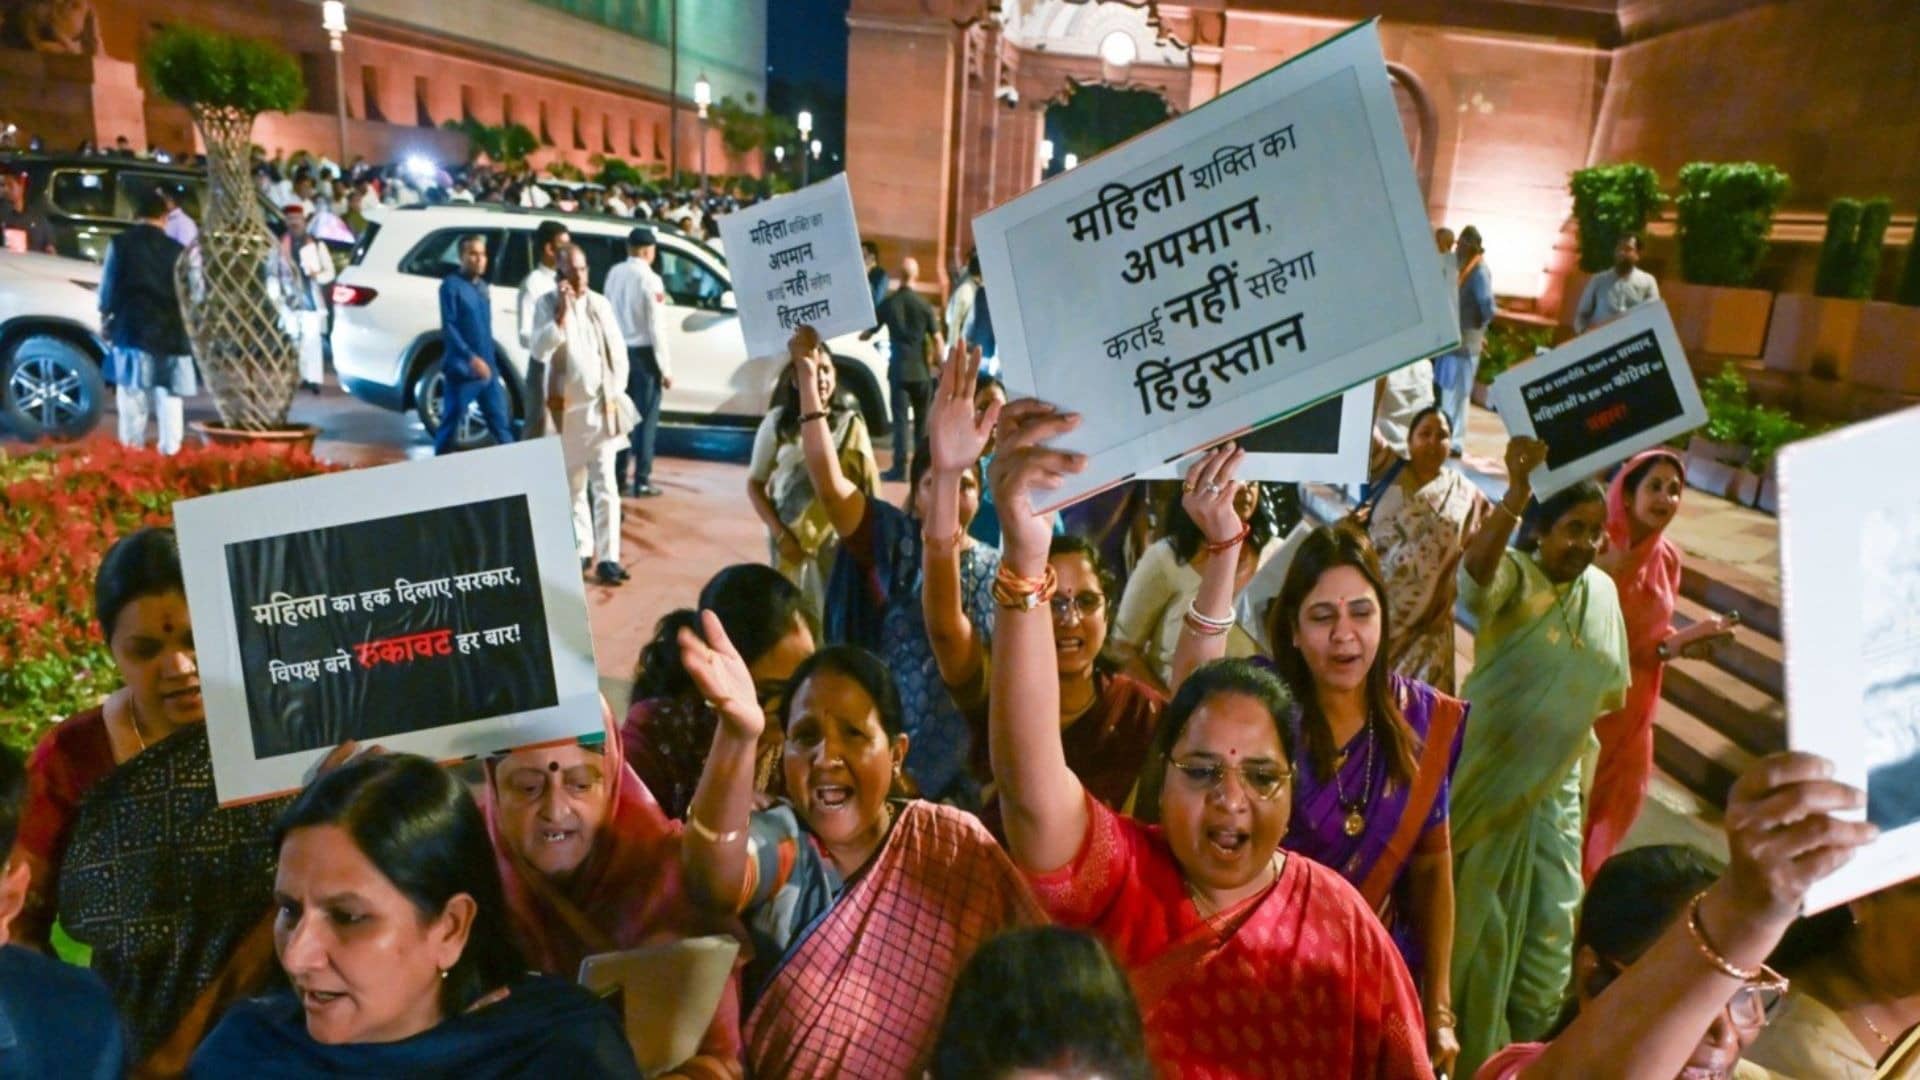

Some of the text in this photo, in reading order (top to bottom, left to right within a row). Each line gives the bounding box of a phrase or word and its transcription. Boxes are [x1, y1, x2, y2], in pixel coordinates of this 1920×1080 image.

[1066, 123, 1297, 245] महिला शक्ति का
[749, 219, 788, 245] महिला
[768, 242, 813, 270] अपमान
[1120, 195, 1273, 285] अपमान,
[784, 269, 809, 296] नहीं
[1103, 250, 1318, 361] कतई नहीं सहेगा
[1134, 312, 1307, 416] हिंदुस्तान
[251, 566, 521, 627] महिला का हक दिलाए सरकार,
[268, 658, 321, 685] विपक्ष
[353, 628, 454, 670] रुकावट
[456, 632, 481, 654] हर
[483, 623, 521, 646] बार!
